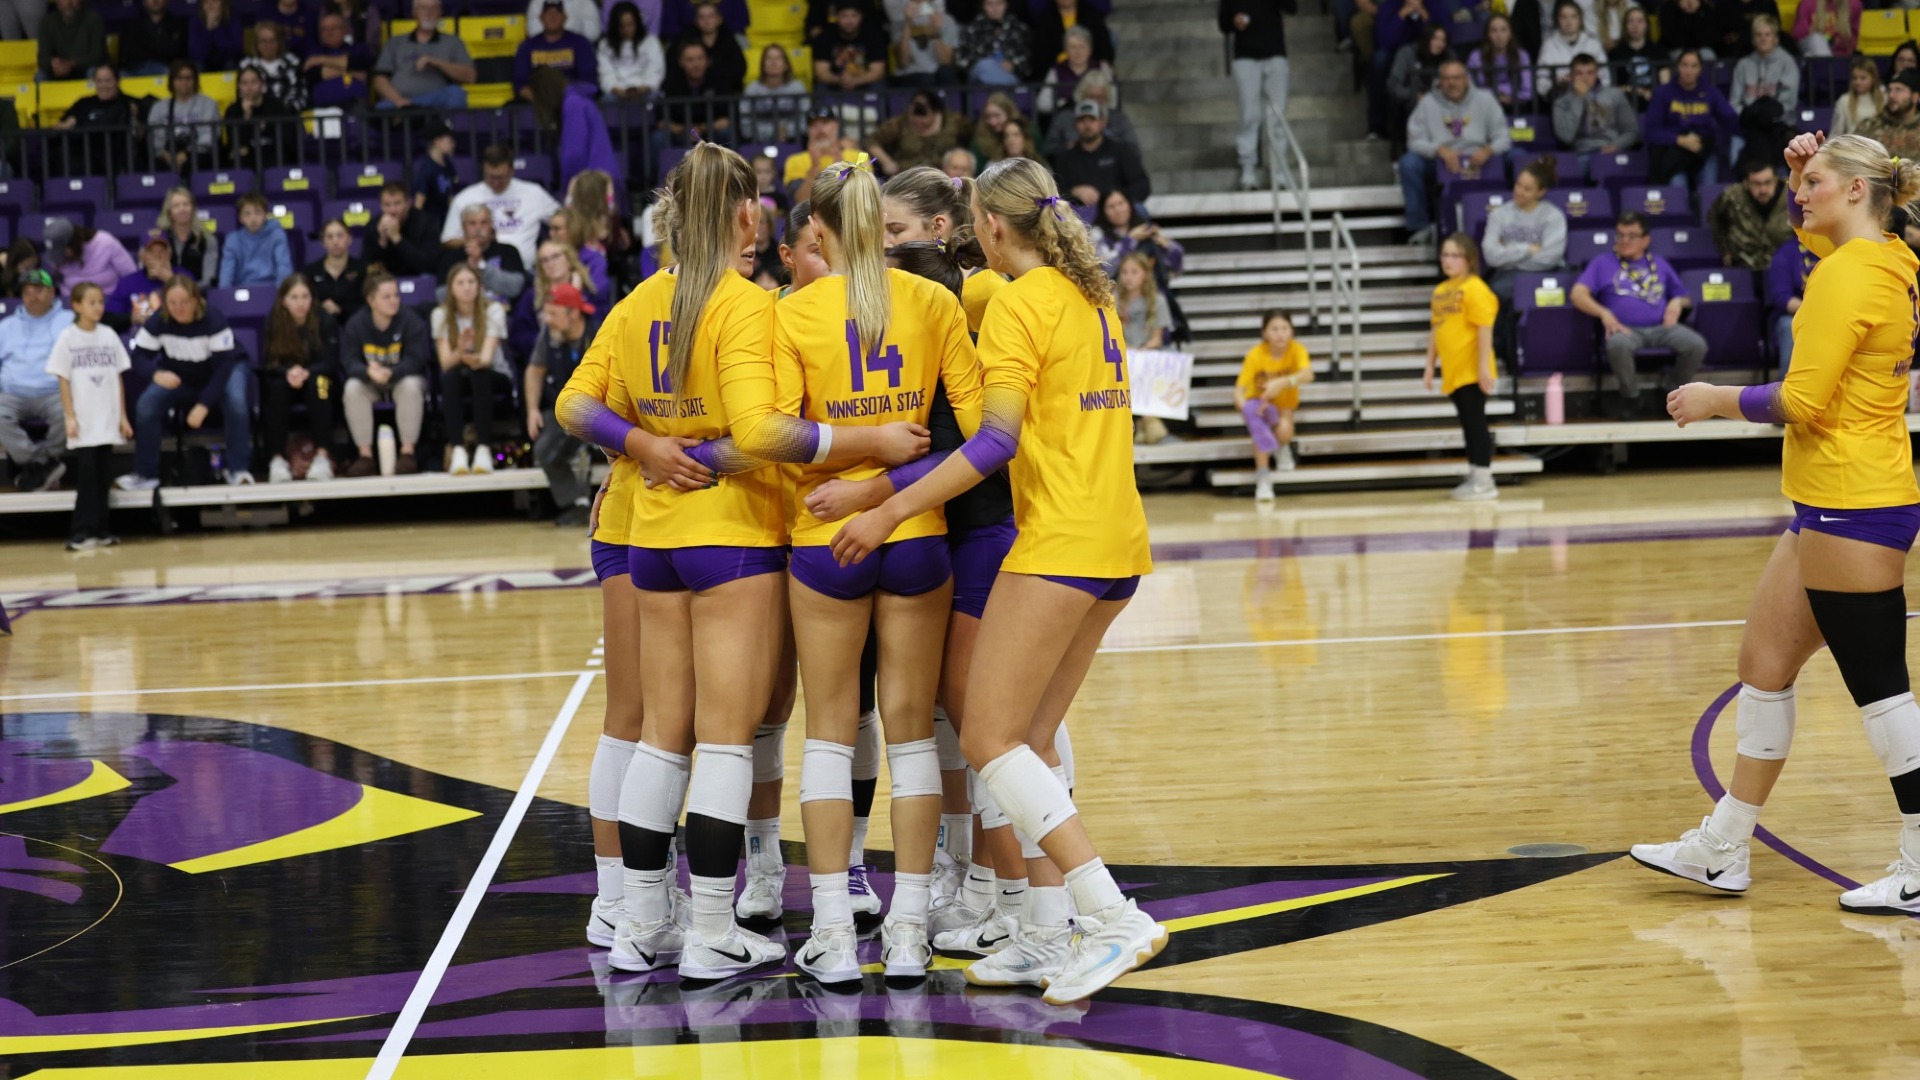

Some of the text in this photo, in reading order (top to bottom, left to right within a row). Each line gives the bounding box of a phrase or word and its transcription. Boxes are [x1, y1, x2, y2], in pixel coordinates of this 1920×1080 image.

[845, 319, 903, 392] 14
[1097, 308, 1123, 382] 4
[636, 397, 708, 418] MINNESOT STATE
[826, 395, 892, 419] MINNESOTA
